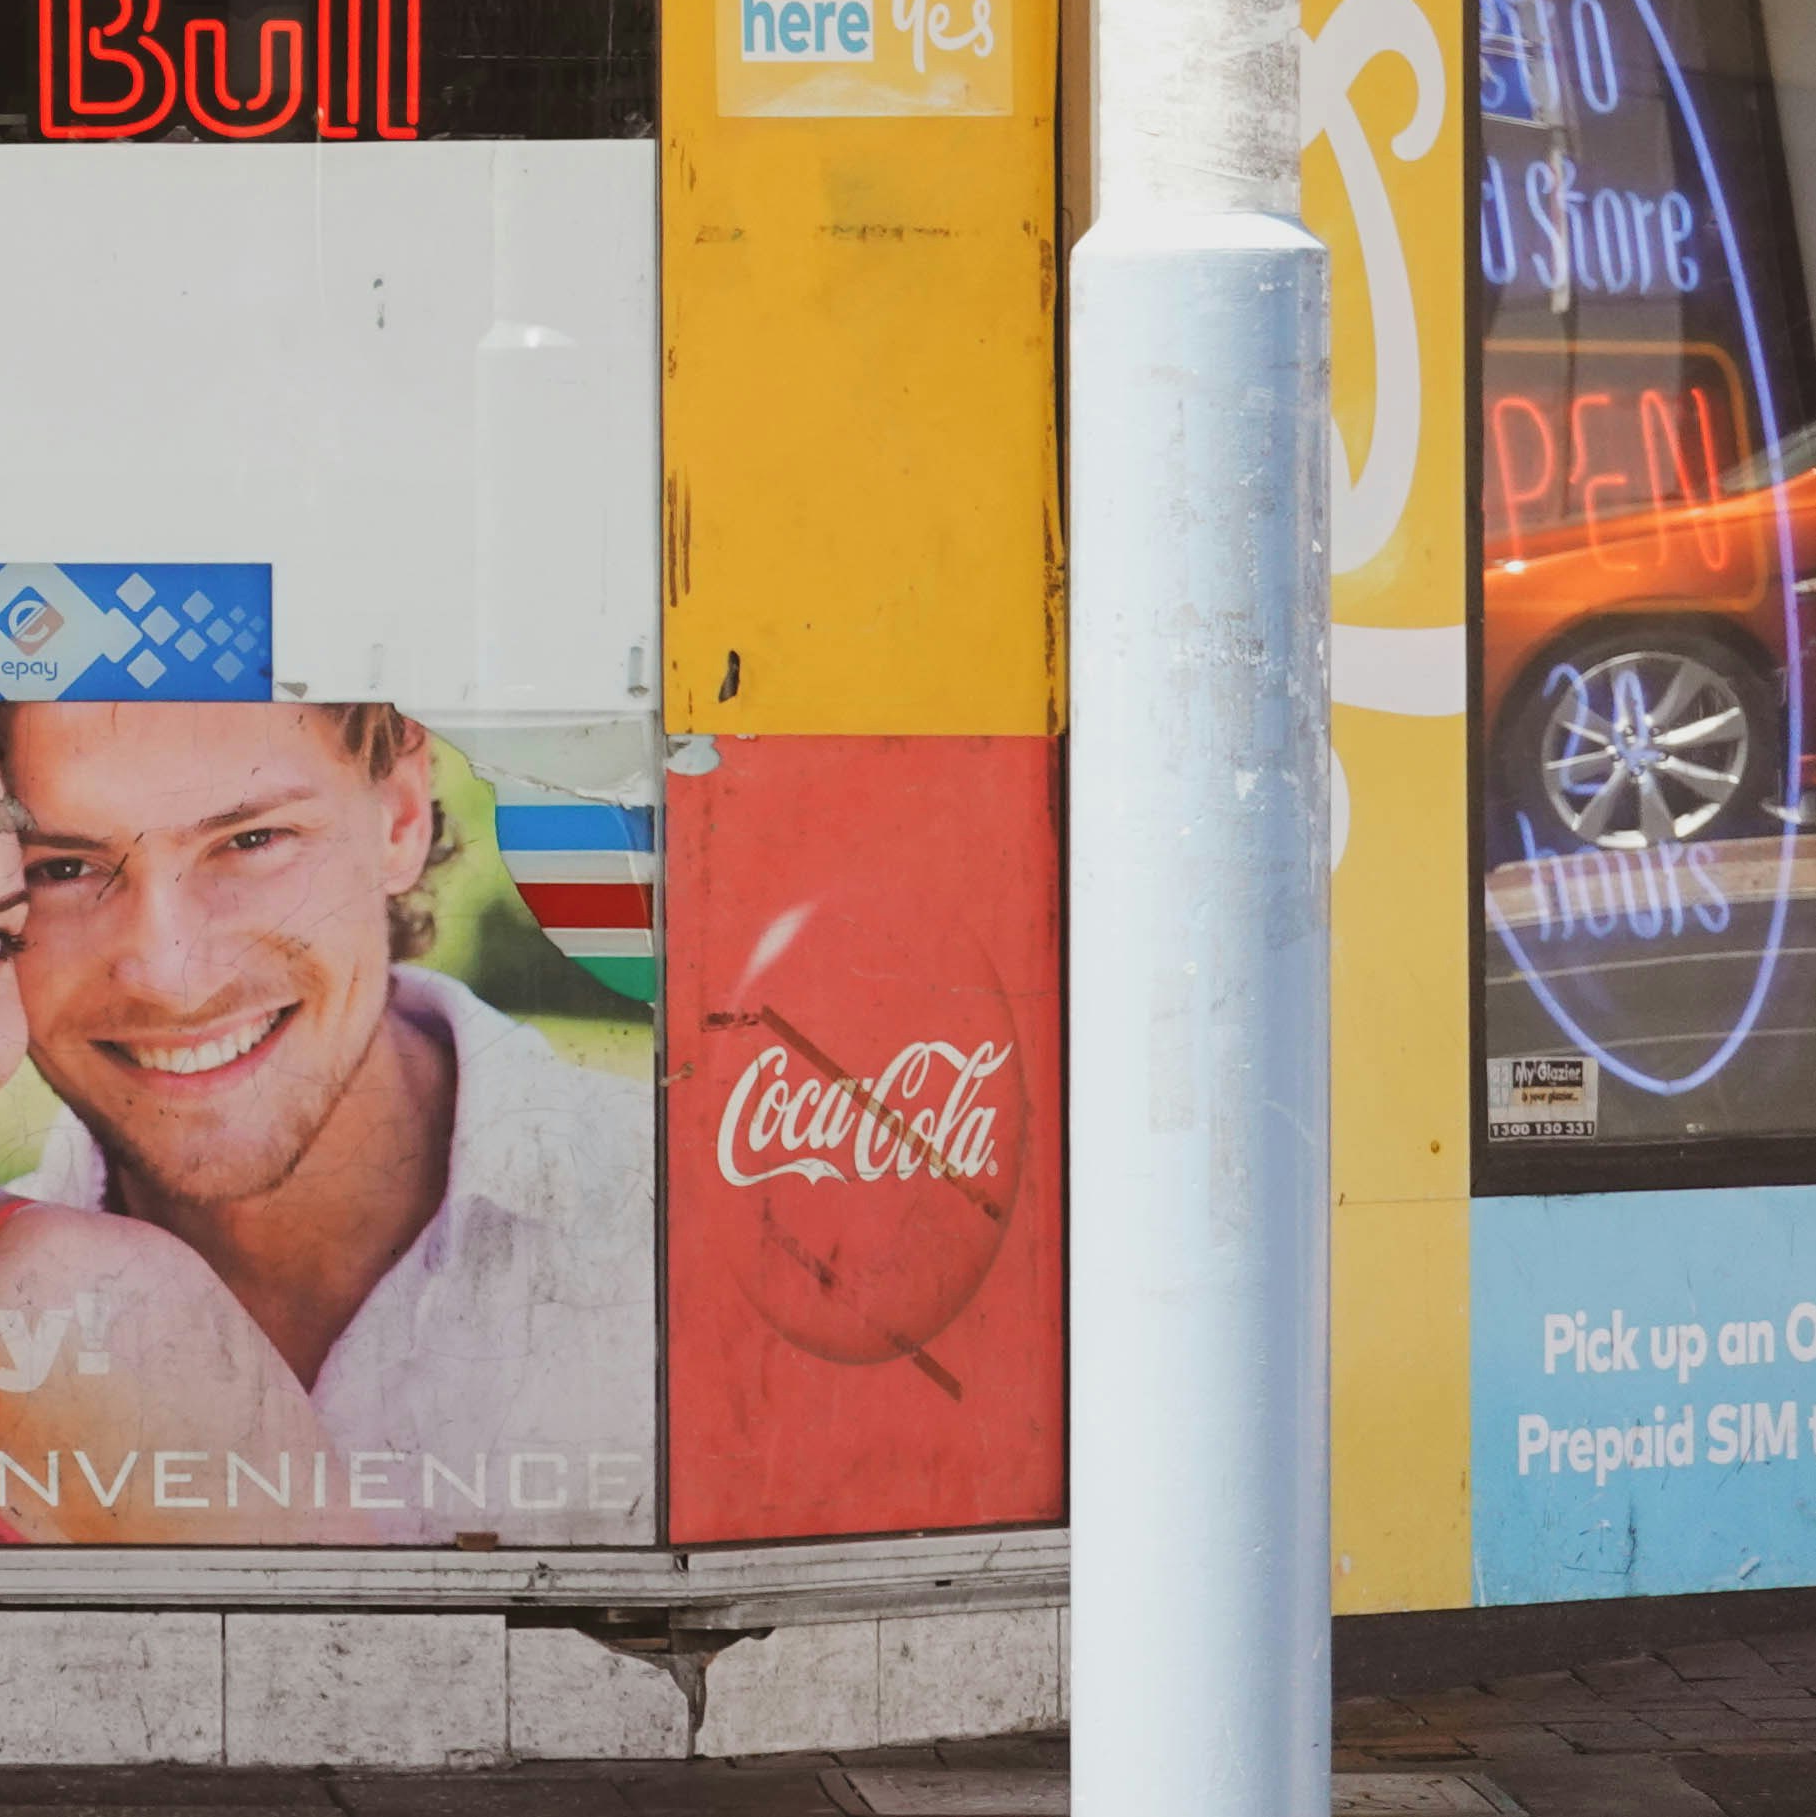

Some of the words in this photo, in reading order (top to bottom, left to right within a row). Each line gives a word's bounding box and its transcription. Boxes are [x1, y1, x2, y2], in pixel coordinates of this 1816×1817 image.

[1524, 154, 1700, 294] Store
[1492, 386, 1727, 572] PEN
[0, 660, 58, 681] epay
[1517, 810, 1730, 942] hours
[1514, 1063, 1535, 1087] My
[1537, 1062, 1581, 1082] Glazier
[1492, 1123, 1530, 1136] 1300
[1534, 1122, 1563, 1135] 130
[1565, 1122, 1593, 1135] 331
[1544, 1309, 1640, 1374] Pick
[1651, 1324, 1708, 1384] up
[1718, 1321, 1775, 1366] an
[1518, 1404, 1695, 1486] Prepaid
[1707, 1400, 1798, 1464] SIM
